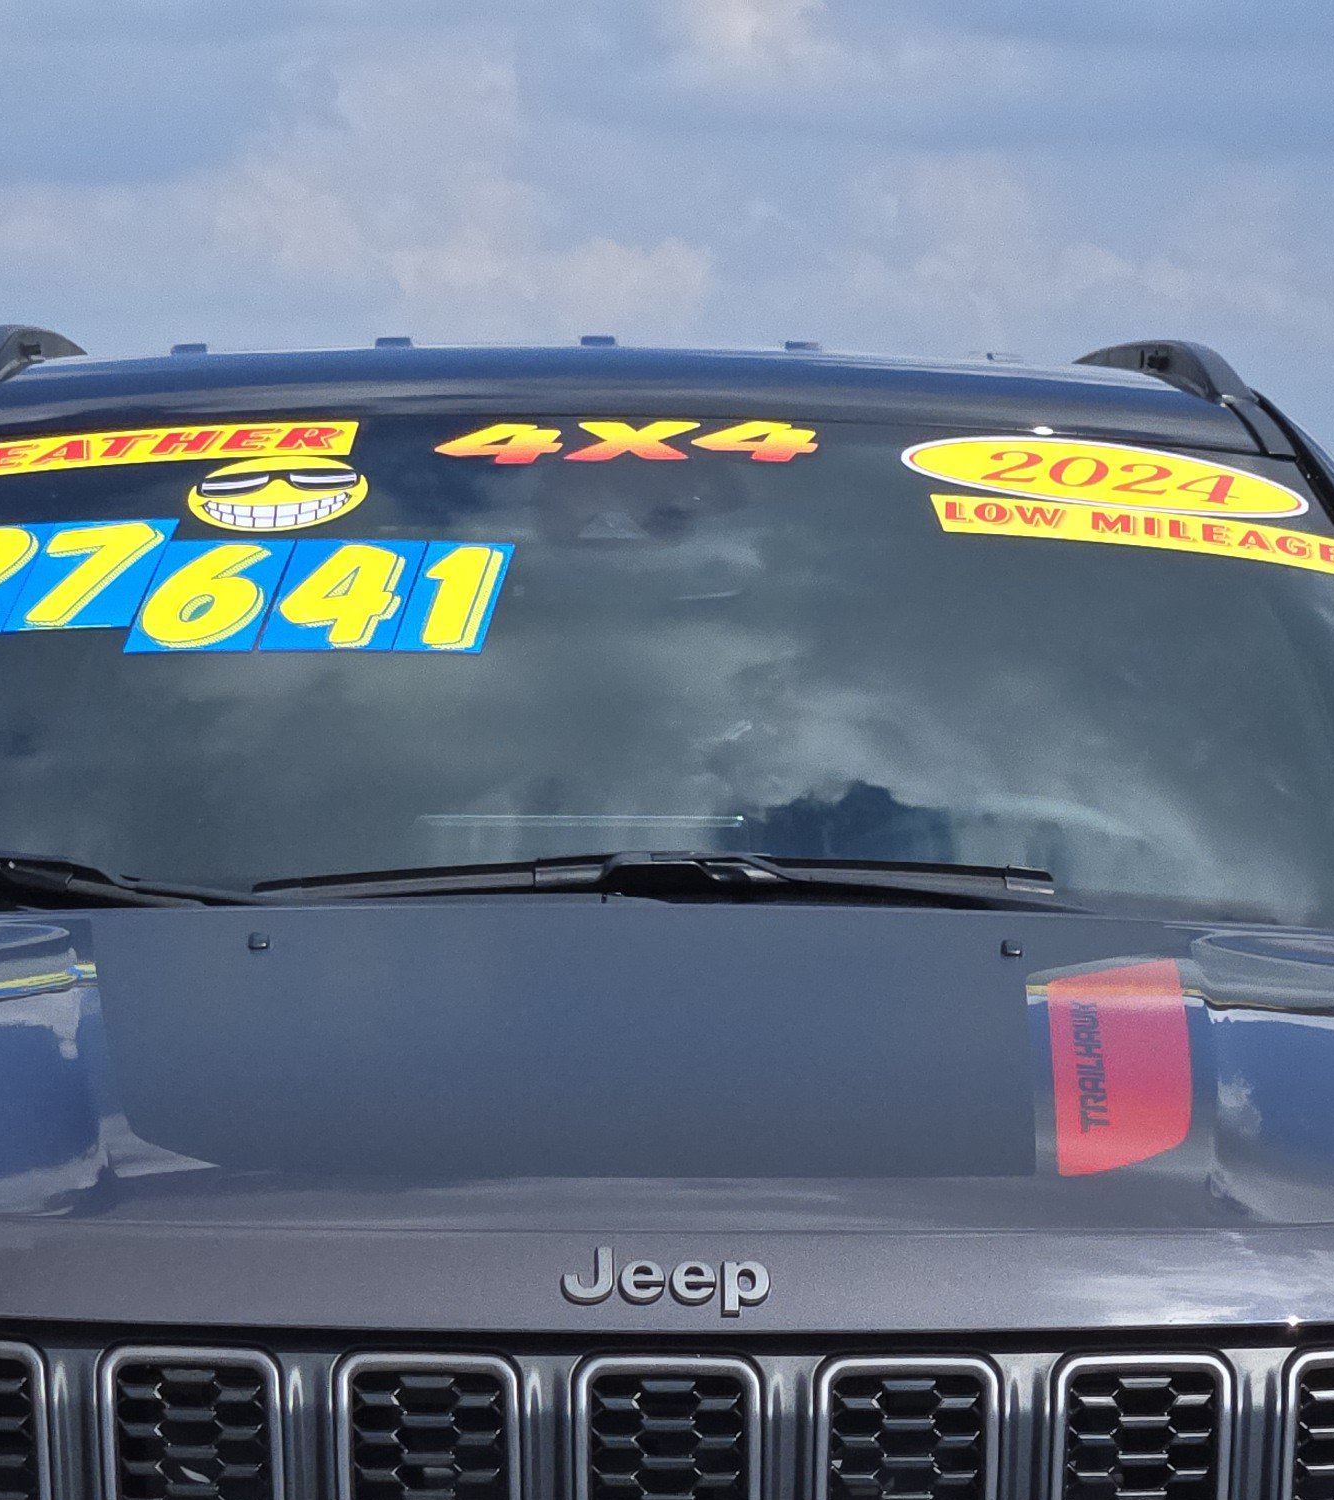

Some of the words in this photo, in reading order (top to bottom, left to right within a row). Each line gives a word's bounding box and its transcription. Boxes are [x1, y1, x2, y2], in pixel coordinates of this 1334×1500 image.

[434, 421, 819, 464] 4X4
[980, 450, 1240, 505] 2024
[944, 500, 1066, 528] LOW
[560, 1246, 771, 1318] Jeep
